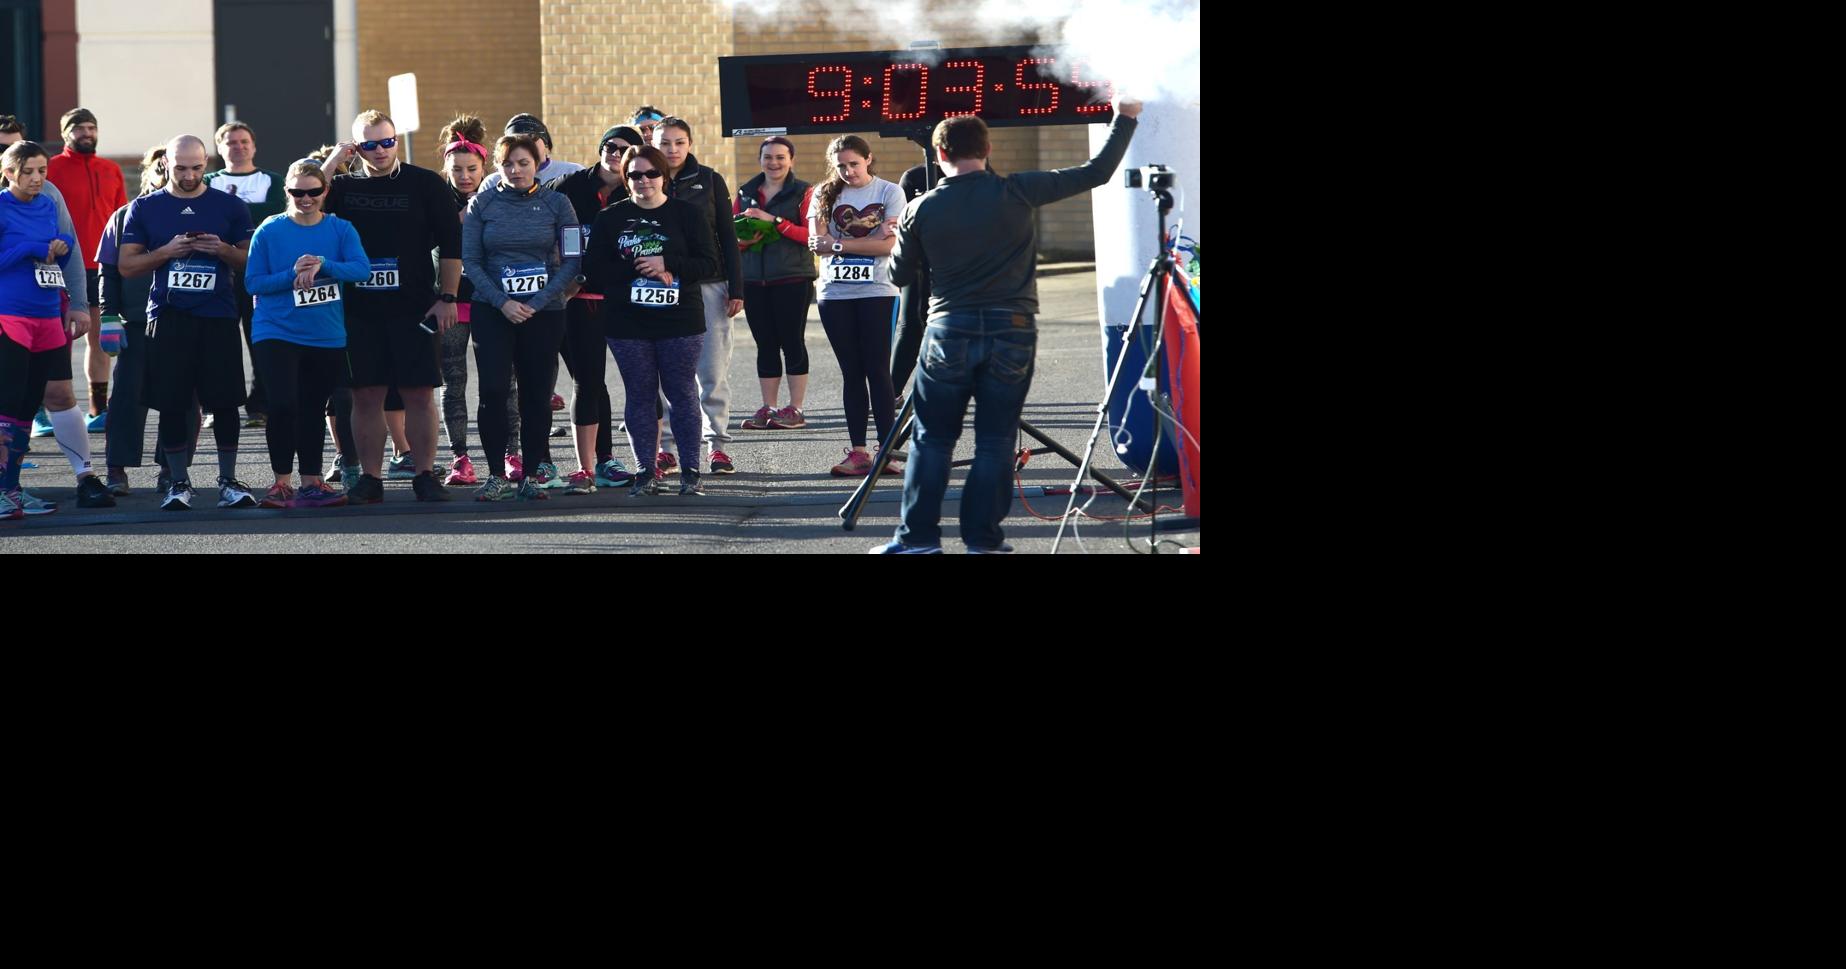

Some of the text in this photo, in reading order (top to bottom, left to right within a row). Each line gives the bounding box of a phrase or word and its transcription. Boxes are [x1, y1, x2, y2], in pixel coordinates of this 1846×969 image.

[172, 272, 213, 288] 1267
[358, 271, 395, 286] 260
[834, 266, 870, 280] 1284
[506, 275, 545, 293] 1276
[298, 285, 337, 304] 1264
[635, 288, 675, 304] 1256
